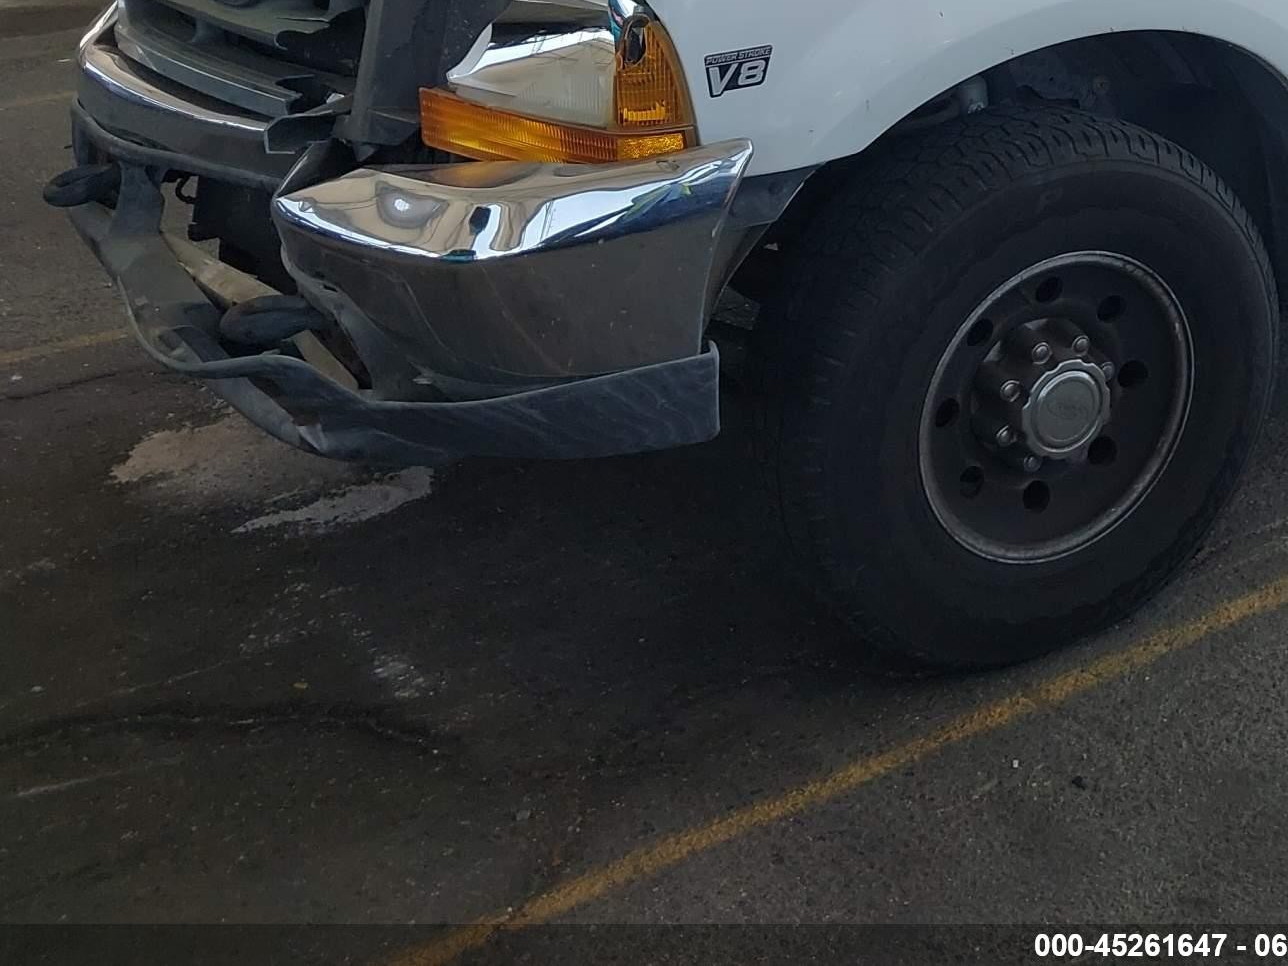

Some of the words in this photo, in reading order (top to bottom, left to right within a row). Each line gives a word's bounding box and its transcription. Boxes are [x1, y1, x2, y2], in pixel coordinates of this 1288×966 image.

[706, 52, 738, 65] POWER
[738, 46, 772, 60] STROKE
[708, 59, 767, 97] V8
